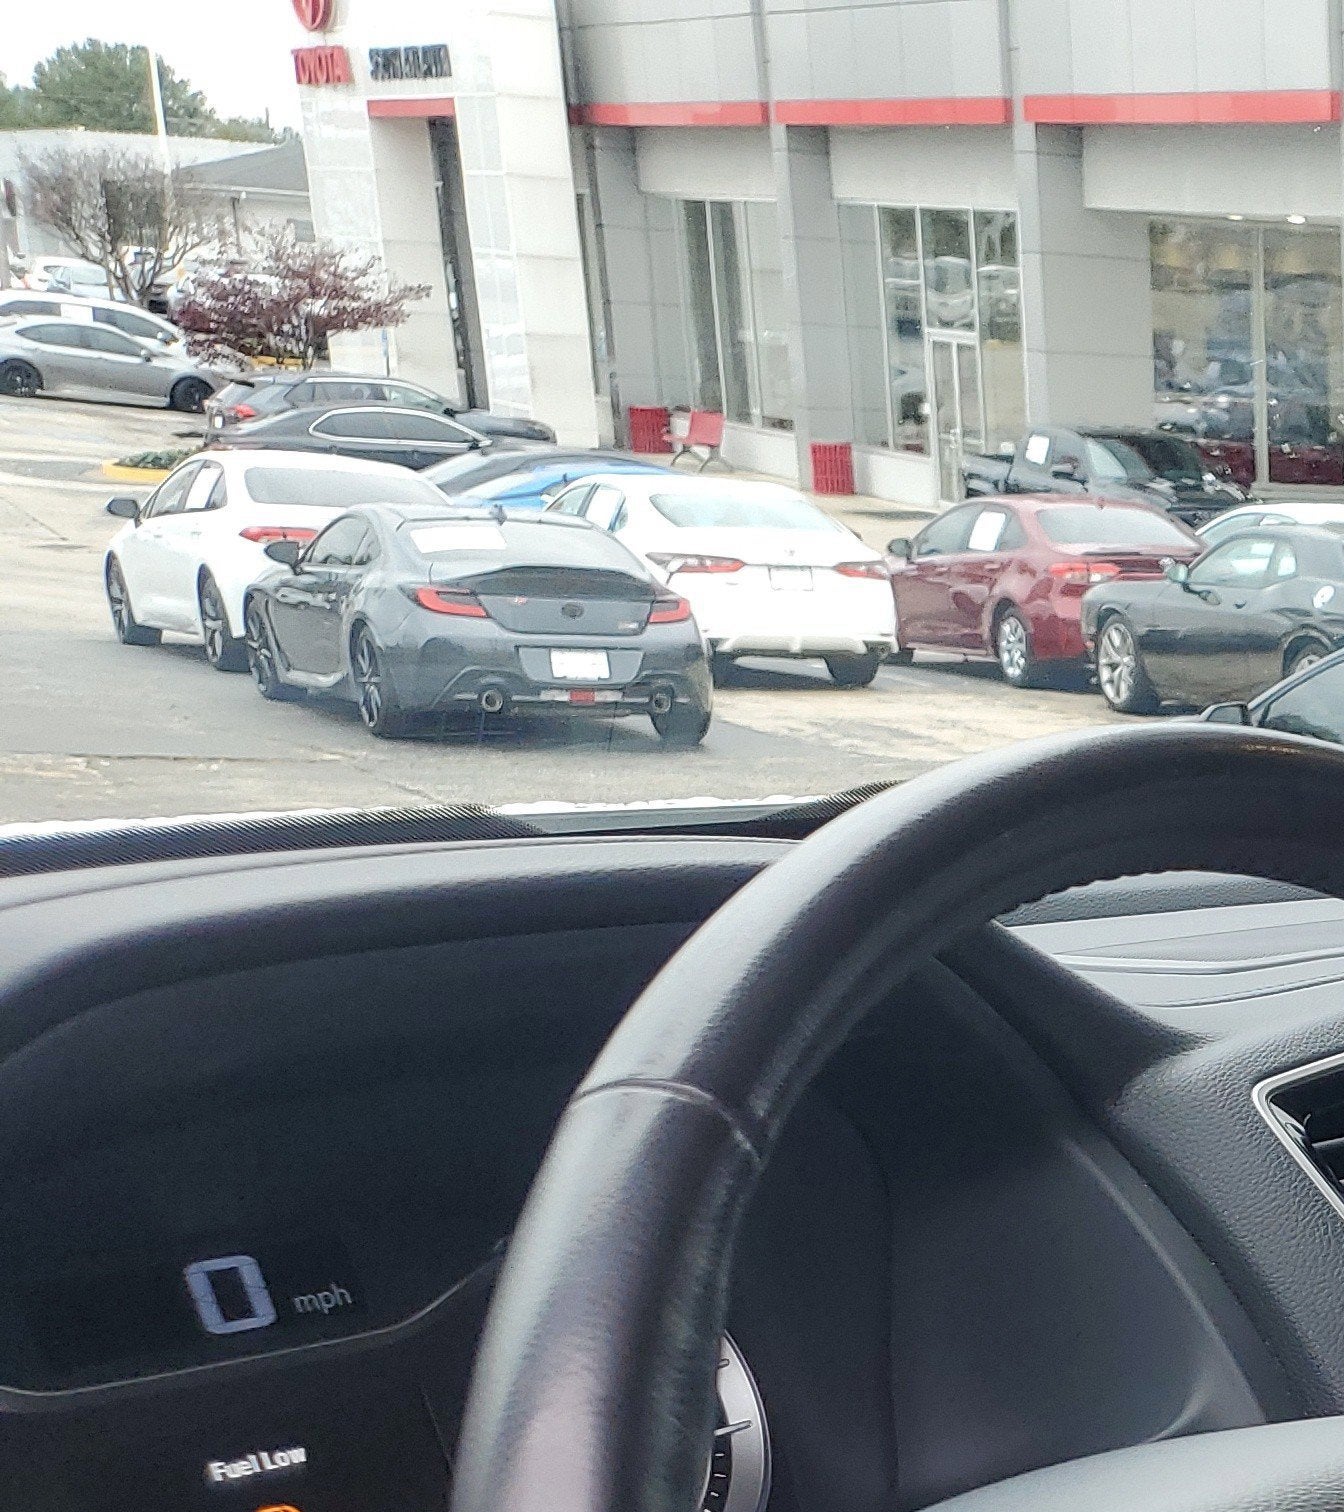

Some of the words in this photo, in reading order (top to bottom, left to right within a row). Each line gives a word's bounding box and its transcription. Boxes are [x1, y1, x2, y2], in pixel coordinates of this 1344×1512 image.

[291, 45, 352, 85] TOYOTA
[183, 1255, 277, 1335] 0
[293, 1281, 353, 1316] mph
[207, 1460, 262, 1482] Fuel
[258, 1447, 307, 1471] Low
